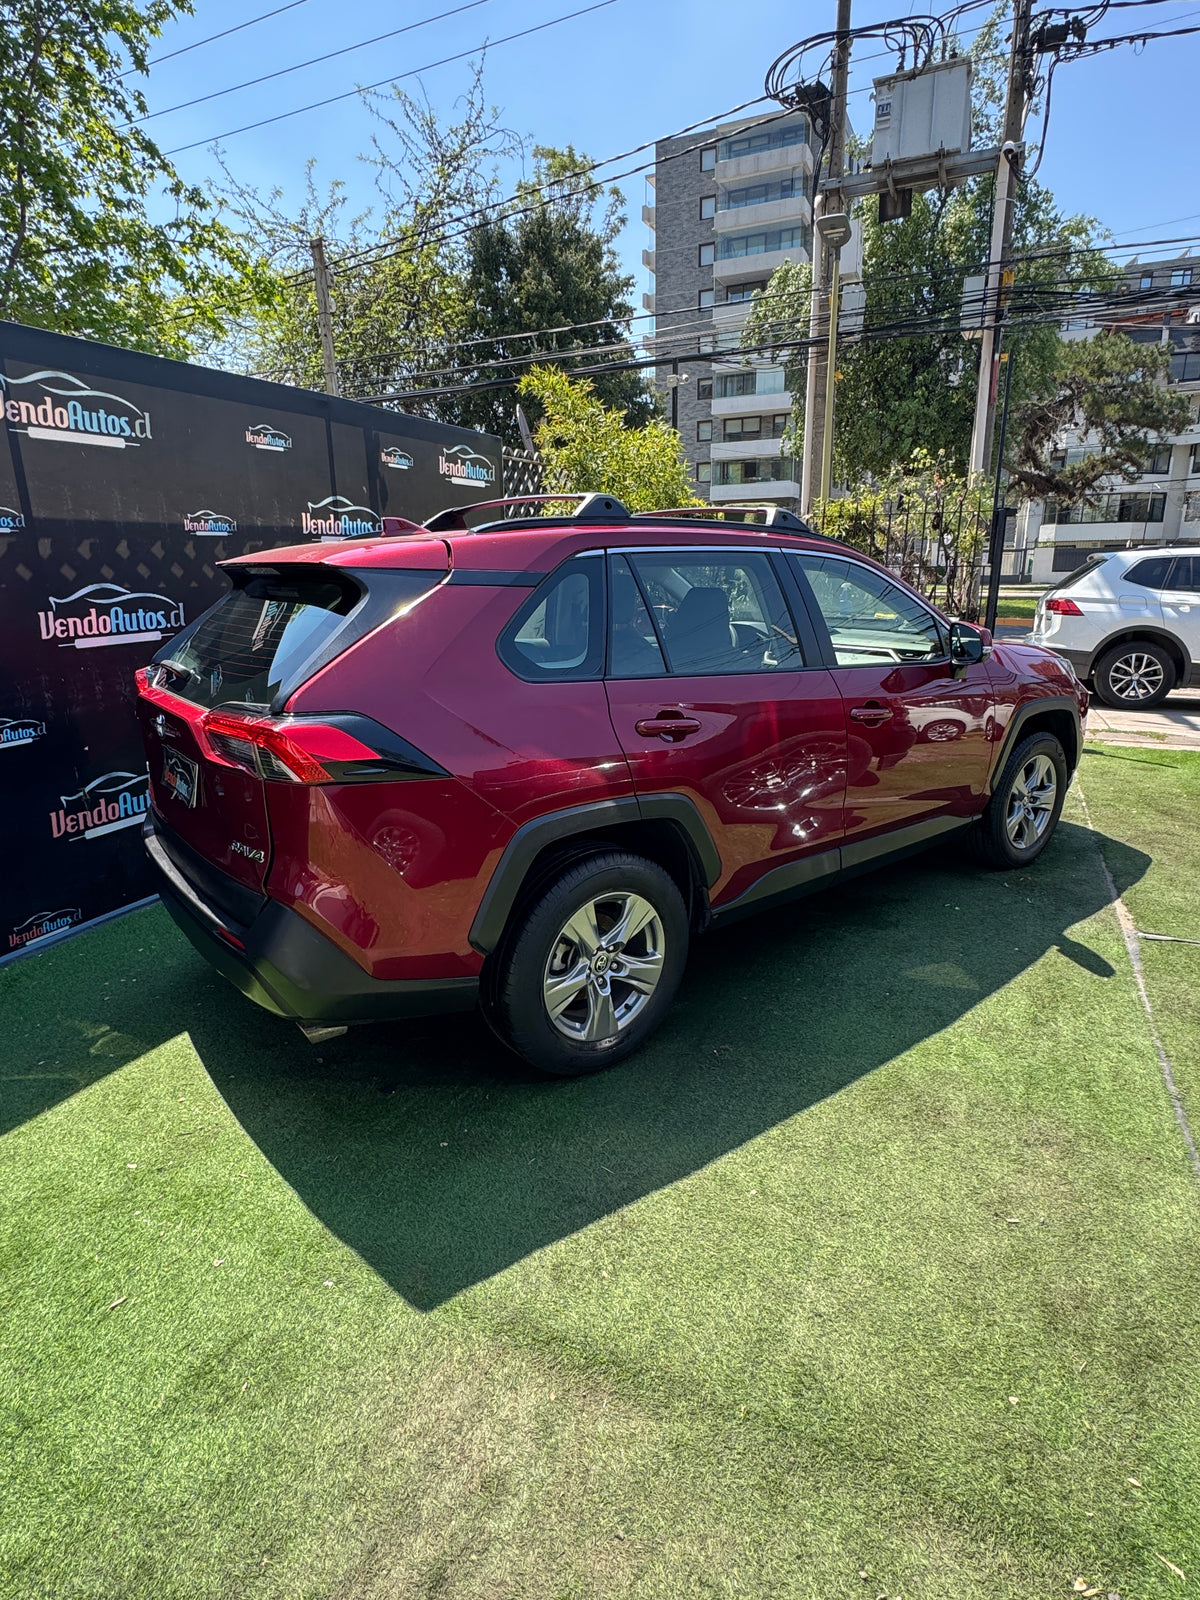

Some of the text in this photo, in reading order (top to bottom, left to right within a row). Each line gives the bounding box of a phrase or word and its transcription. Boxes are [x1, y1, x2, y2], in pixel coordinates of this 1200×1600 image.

[0, 390, 153, 440] endoAutos.cl
[245, 430, 292, 448] VendoAutos.cl
[439, 456, 495, 481] VendoAutos.cl
[184, 518, 237, 532] VendoAutos.cl
[38, 602, 186, 640] VendoAutos.cl
[49, 789, 151, 838] VendoAut
[231, 840, 265, 863] RAV4
[9, 908, 82, 947] VendoAutos.cl
